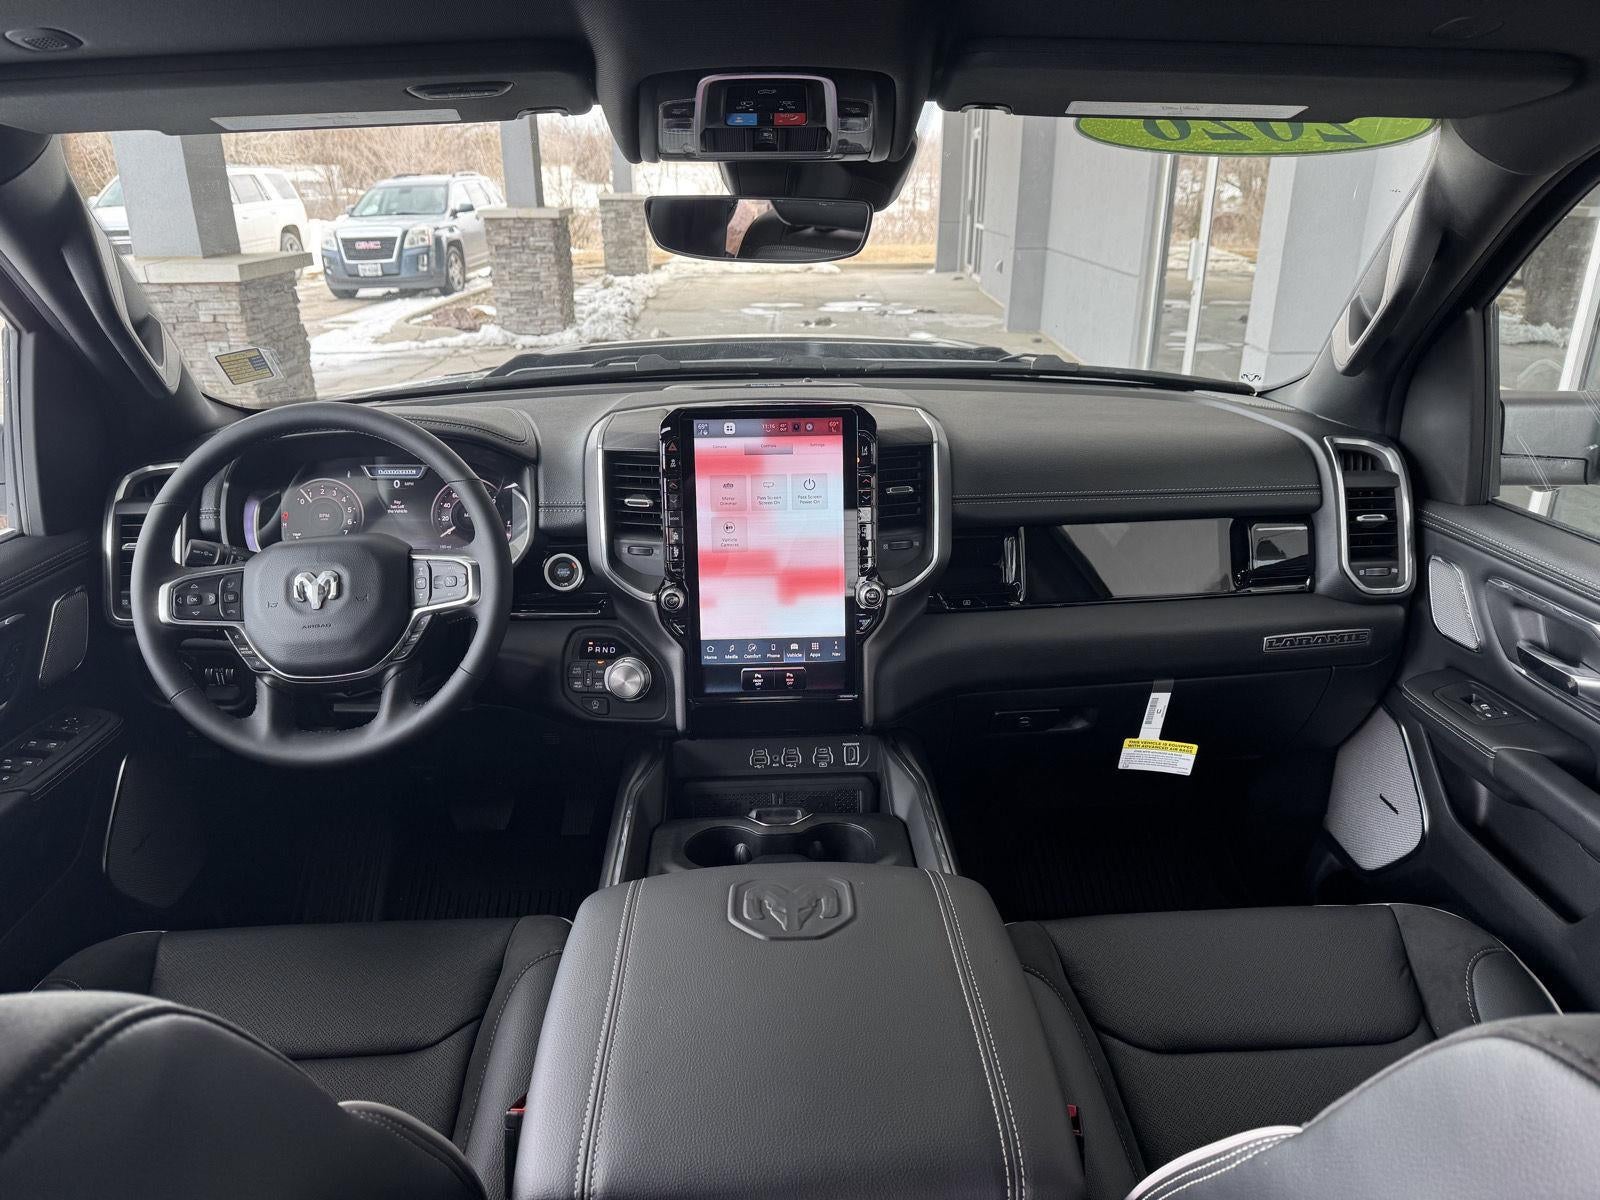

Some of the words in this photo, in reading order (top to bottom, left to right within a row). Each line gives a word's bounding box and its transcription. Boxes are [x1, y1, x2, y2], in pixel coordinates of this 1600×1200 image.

[354, 241, 381, 249] GMC
[393, 480, 400, 488] 0
[1267, 632, 1368, 648] LARAMIE
